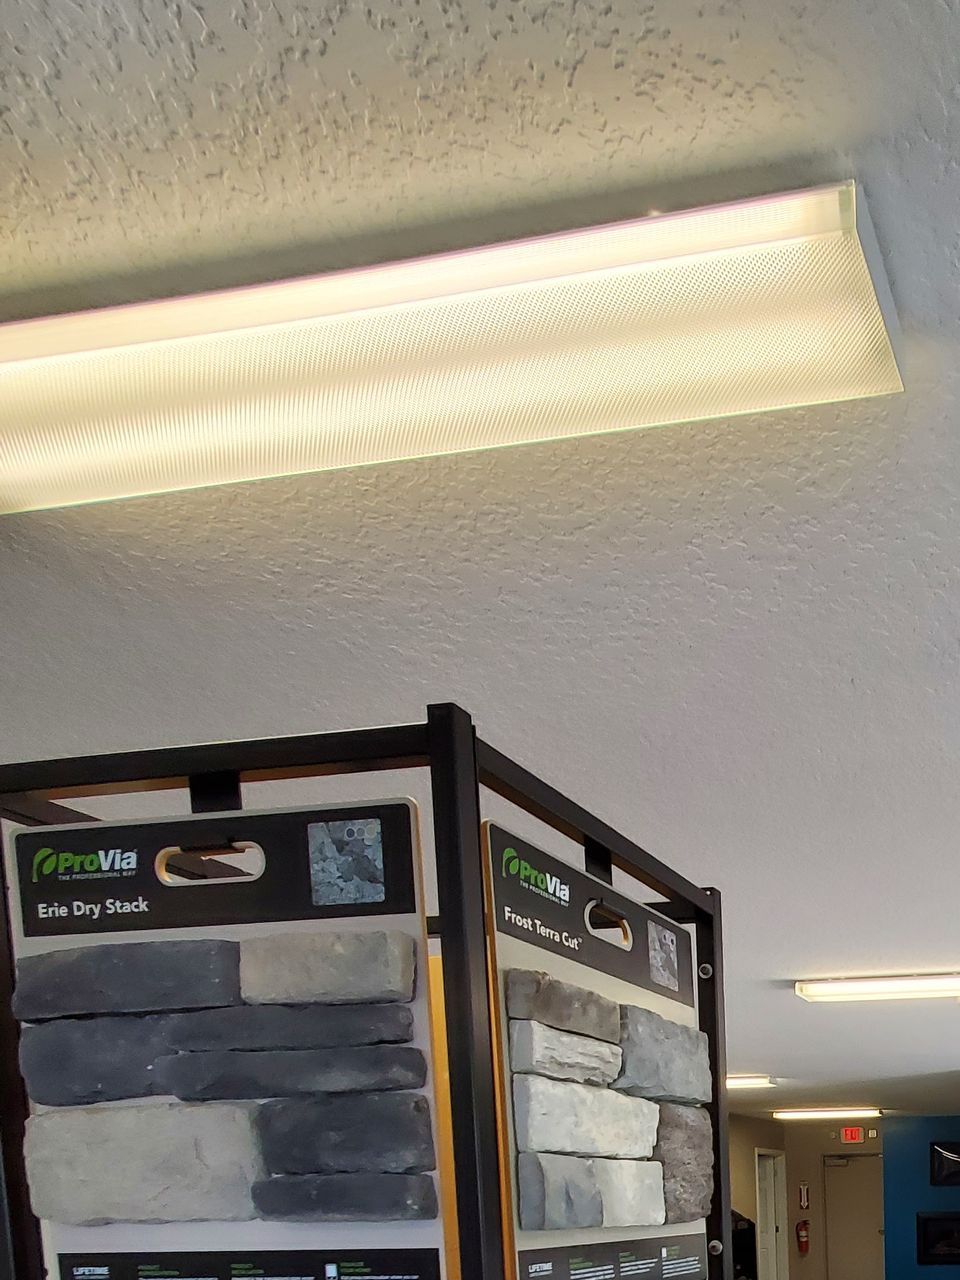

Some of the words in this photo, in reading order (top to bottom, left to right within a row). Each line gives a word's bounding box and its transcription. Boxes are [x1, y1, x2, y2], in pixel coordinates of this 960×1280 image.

[58, 848, 138, 873] ProVia
[520, 860, 570, 902] ProVia
[37, 902, 69, 918] Erie
[72, 901, 101, 919] Dry
[105, 896, 149, 914] Stack
[504, 905, 533, 931] Frost
[534, 919, 561, 943] Terra
